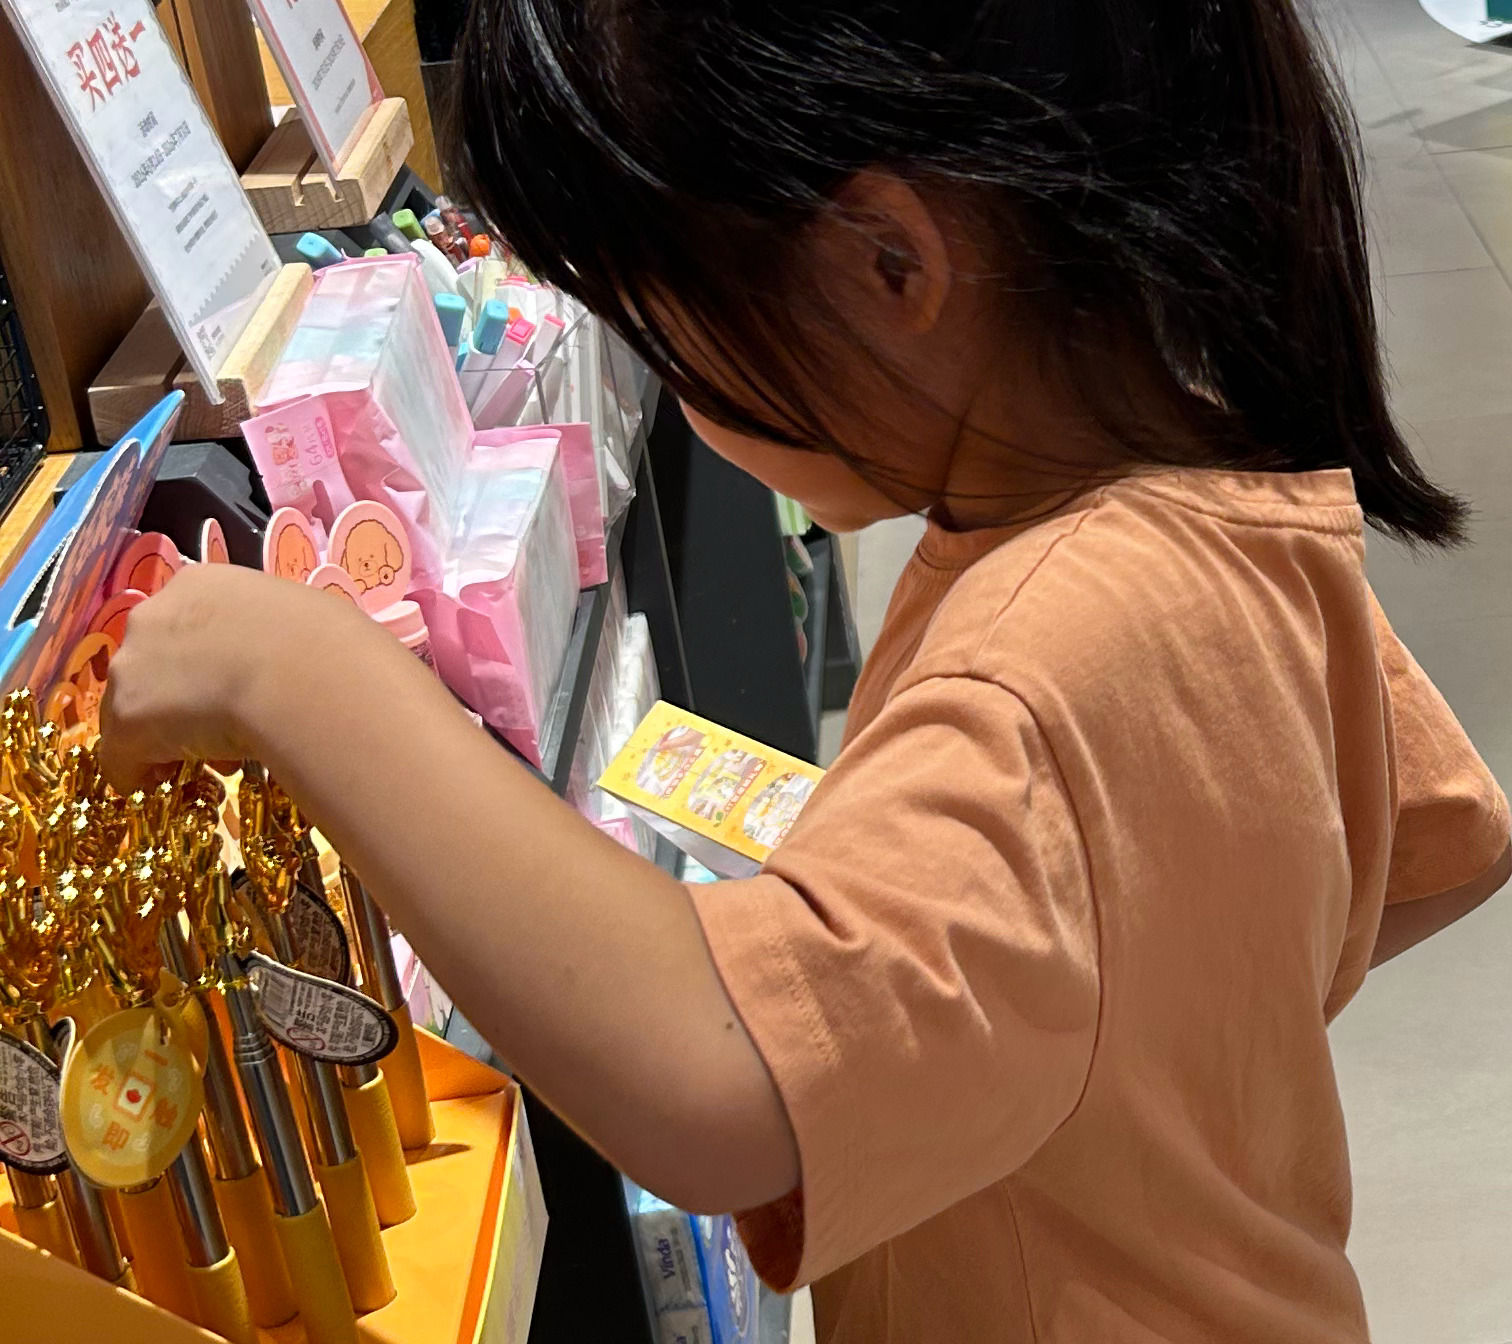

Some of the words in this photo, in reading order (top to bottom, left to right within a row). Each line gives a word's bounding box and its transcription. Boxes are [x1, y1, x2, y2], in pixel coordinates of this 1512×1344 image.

[64, 4, 149, 113] 买四送一
[658, 1235, 676, 1282] Vinda
